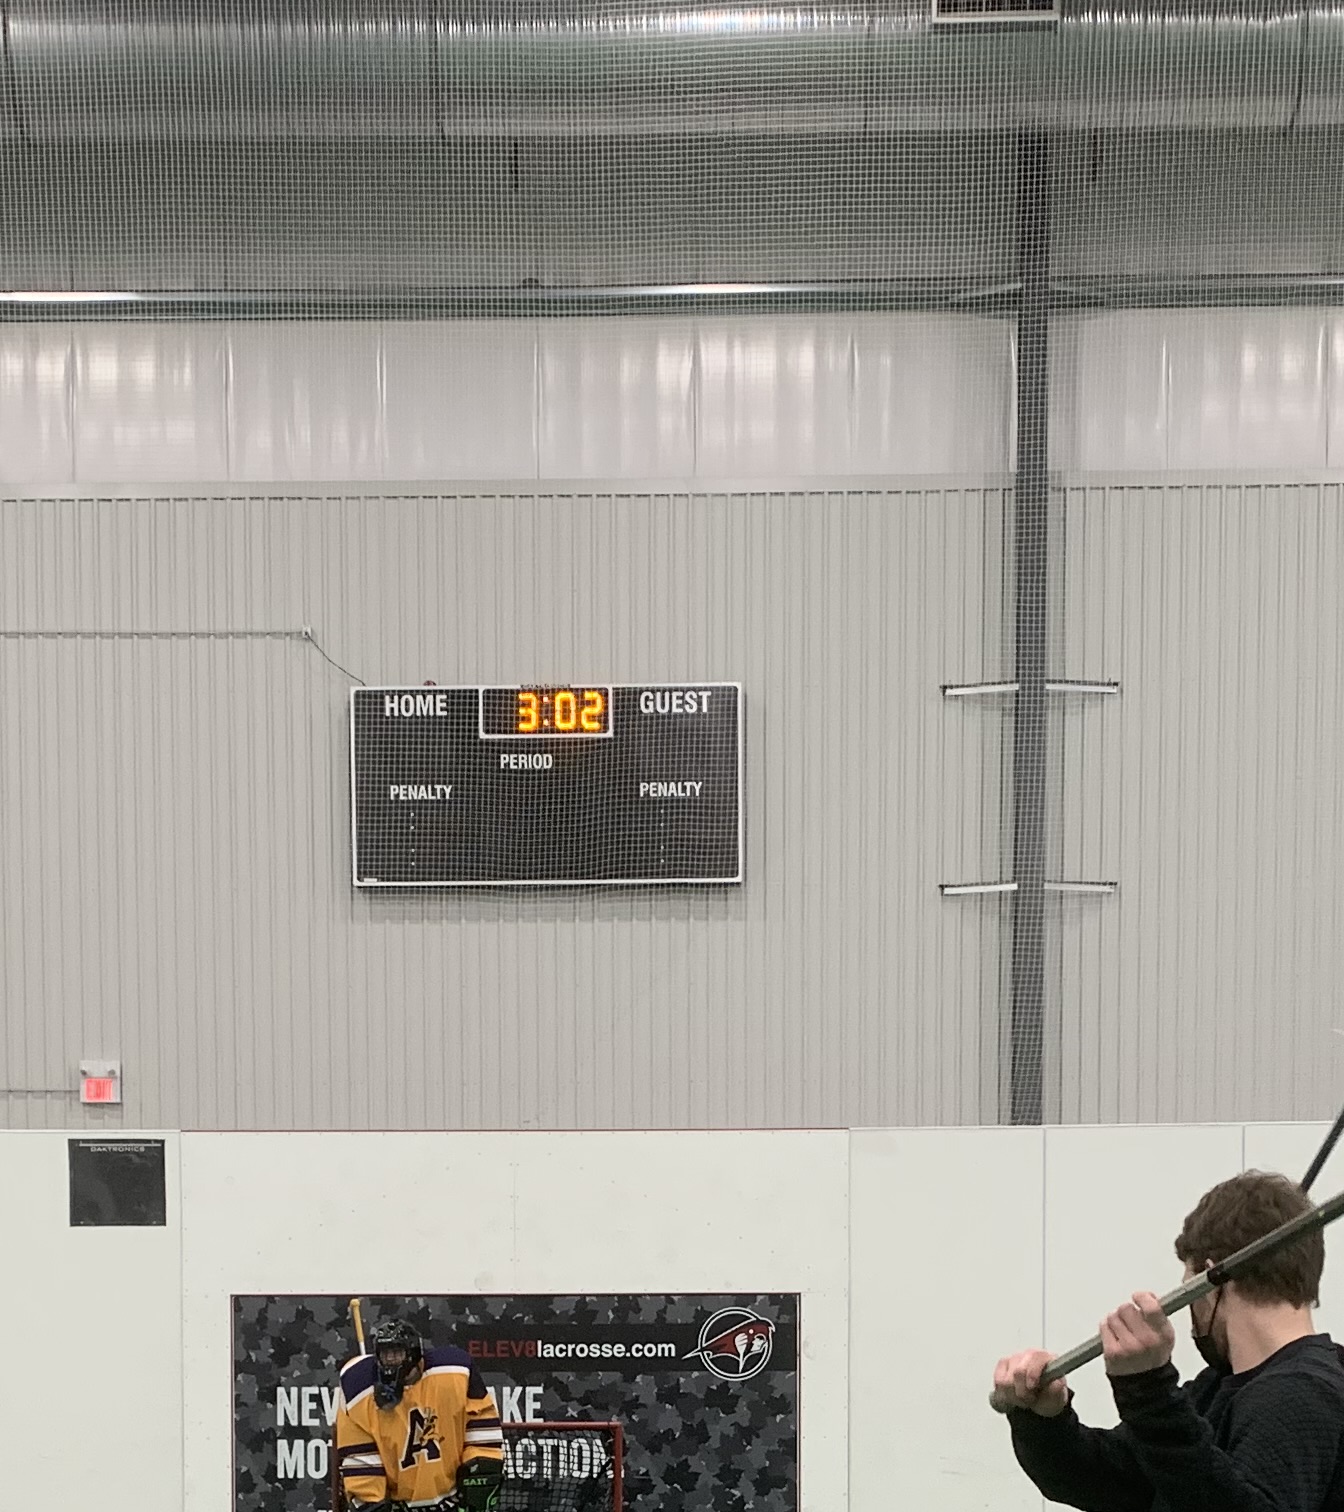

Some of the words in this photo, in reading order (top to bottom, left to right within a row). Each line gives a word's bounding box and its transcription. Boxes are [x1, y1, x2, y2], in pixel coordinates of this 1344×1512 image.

[384, 694, 448, 717] HOME
[518, 691, 604, 731] 3:02
[639, 691, 712, 714] GUEST
[500, 753, 553, 769] PERIOD
[389, 785, 453, 800] PENALTY
[639, 782, 703, 797] PENALTY
[276, 1386, 340, 1427] NEV
[463, 1477, 488, 1486] GAIT
